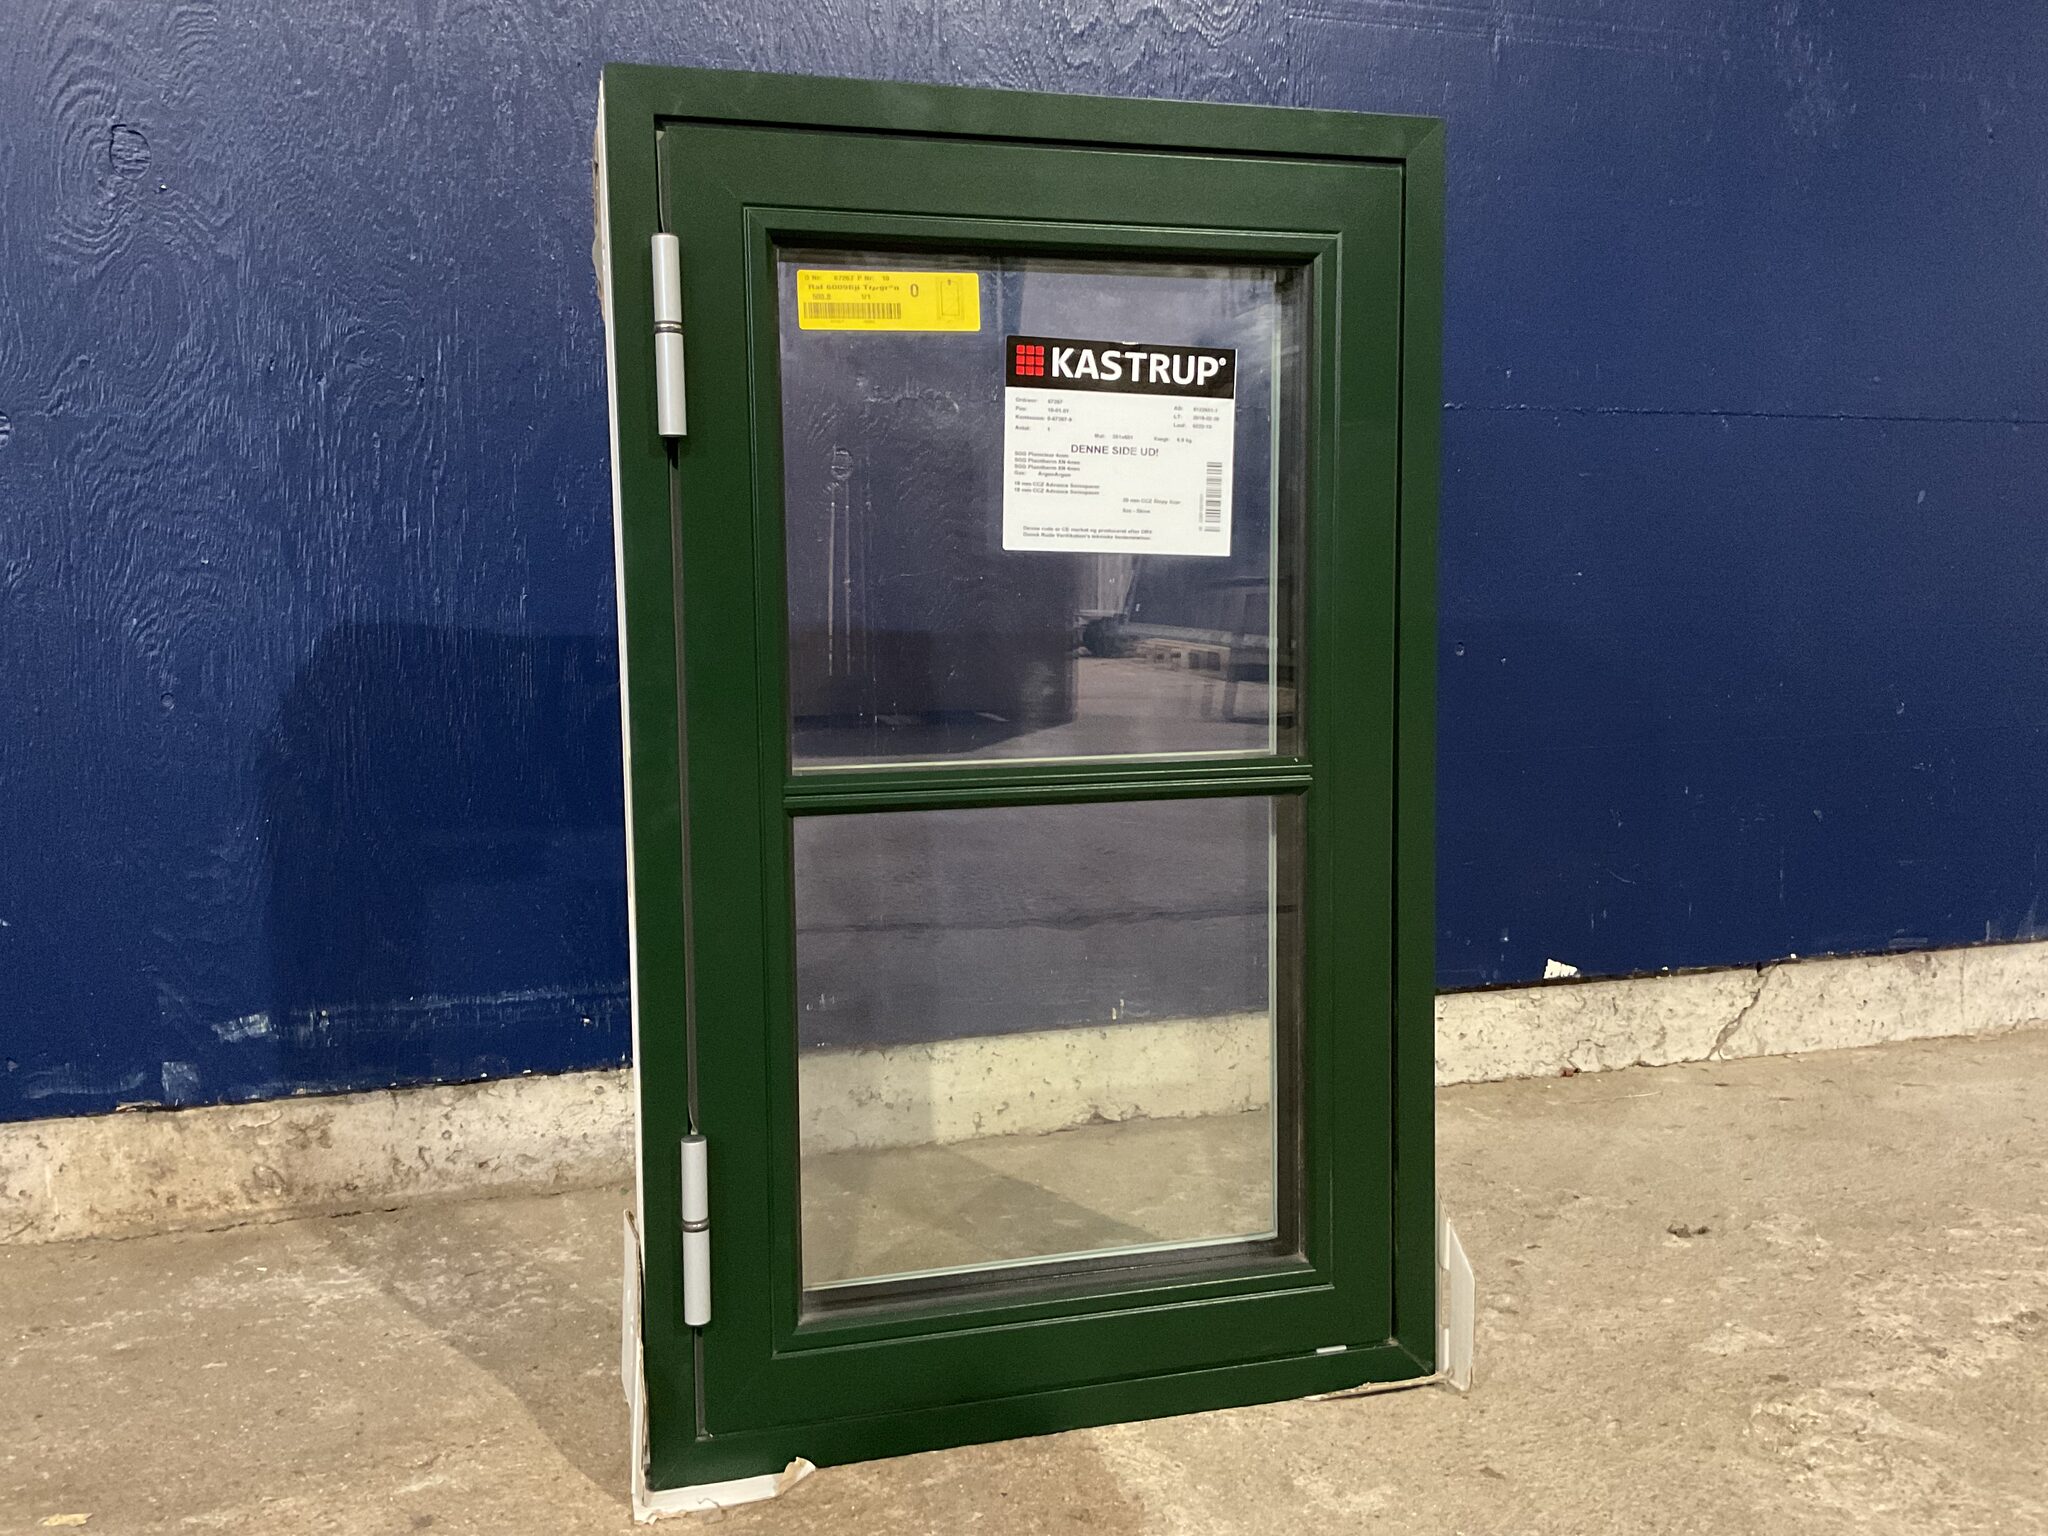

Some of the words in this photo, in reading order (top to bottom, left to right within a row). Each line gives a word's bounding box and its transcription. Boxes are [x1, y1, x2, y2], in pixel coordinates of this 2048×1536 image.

[1051, 347, 1219, 386] KASTRUP
[1071, 444, 1109, 455] DENNE
[1112, 446, 1137, 456] SIDE
[1140, 447, 1159, 457] UD!
